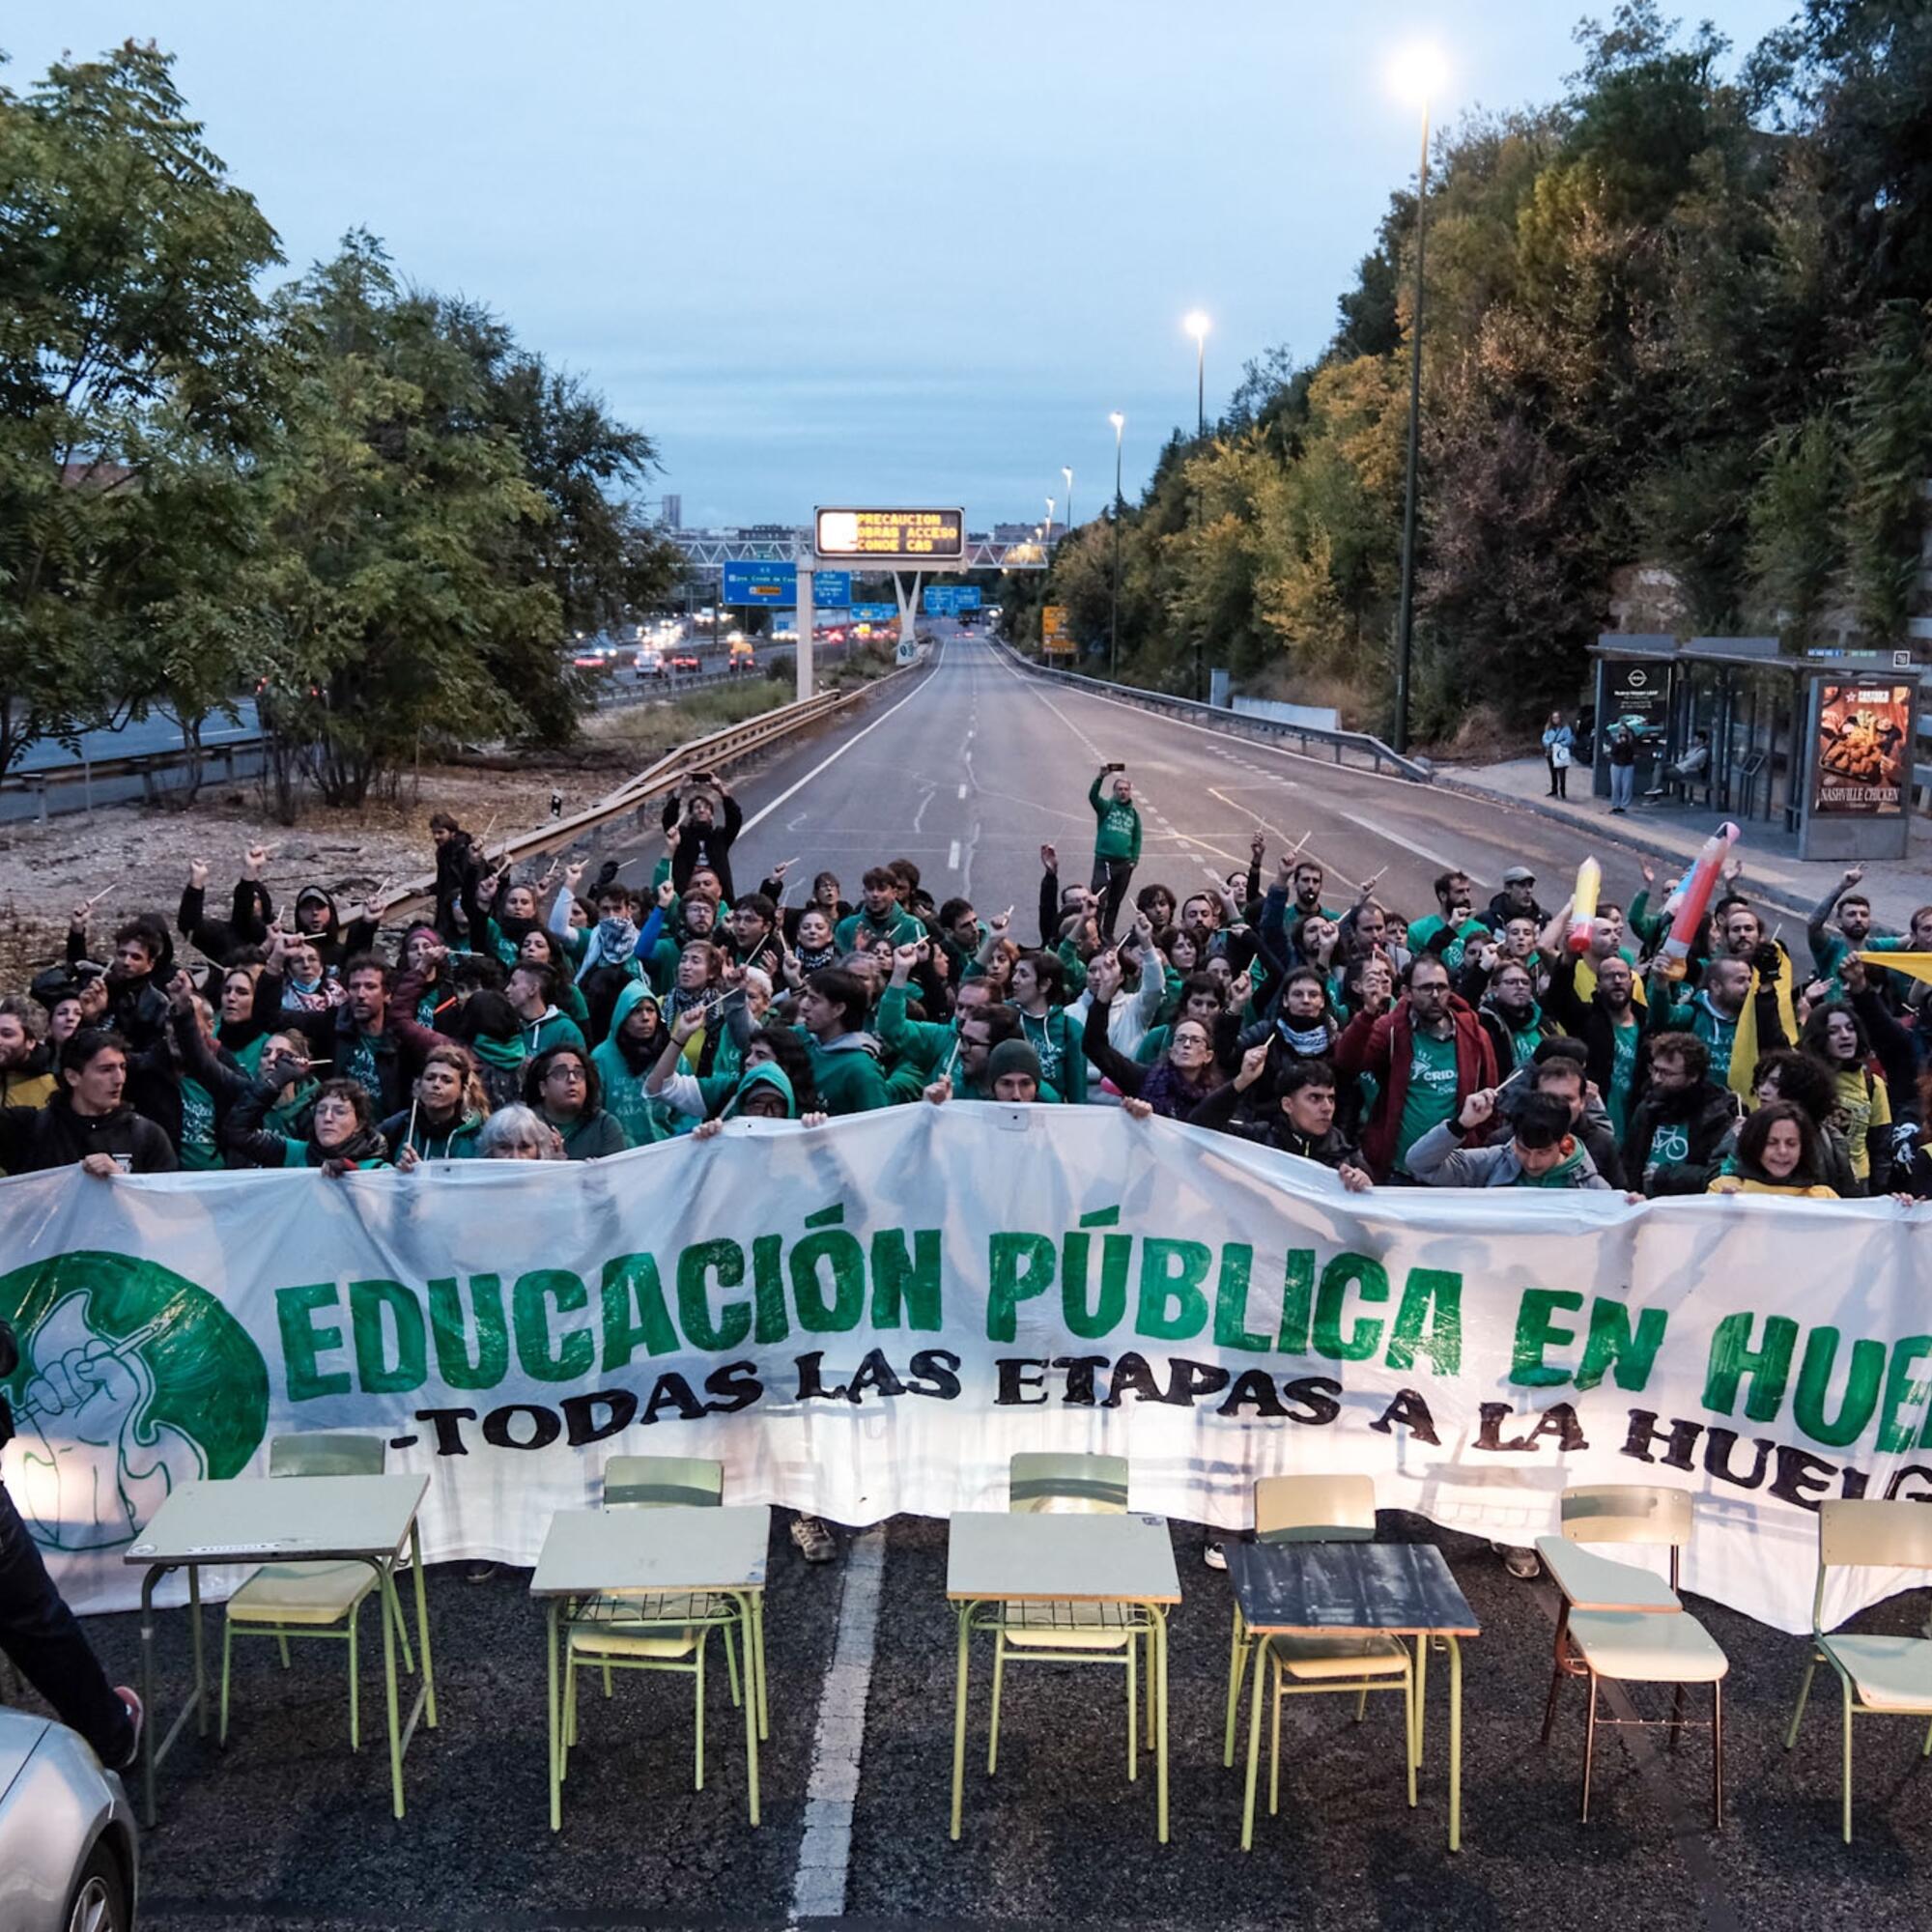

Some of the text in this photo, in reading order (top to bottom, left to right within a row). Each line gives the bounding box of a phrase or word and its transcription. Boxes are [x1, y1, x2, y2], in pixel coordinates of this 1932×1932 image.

[857, 513, 942, 525] PRECAUCION
[858, 526, 957, 538] OBRAS ACCESO
[858, 540, 933, 552] CONDE CAS
[1820, 787, 1899, 802] NASHVILLE CHICKEN
[1423, 1069, 1458, 1081] CRID
[275, 1203, 1932, 1454] EDUCACIÓN PÚBLICA EN HUE
[795, 1349, 962, 1405] LAS
[995, 1352, 1343, 1426] ETAPAS
[1370, 1389, 1440, 1446] A
[1471, 1402, 1589, 1452] LA
